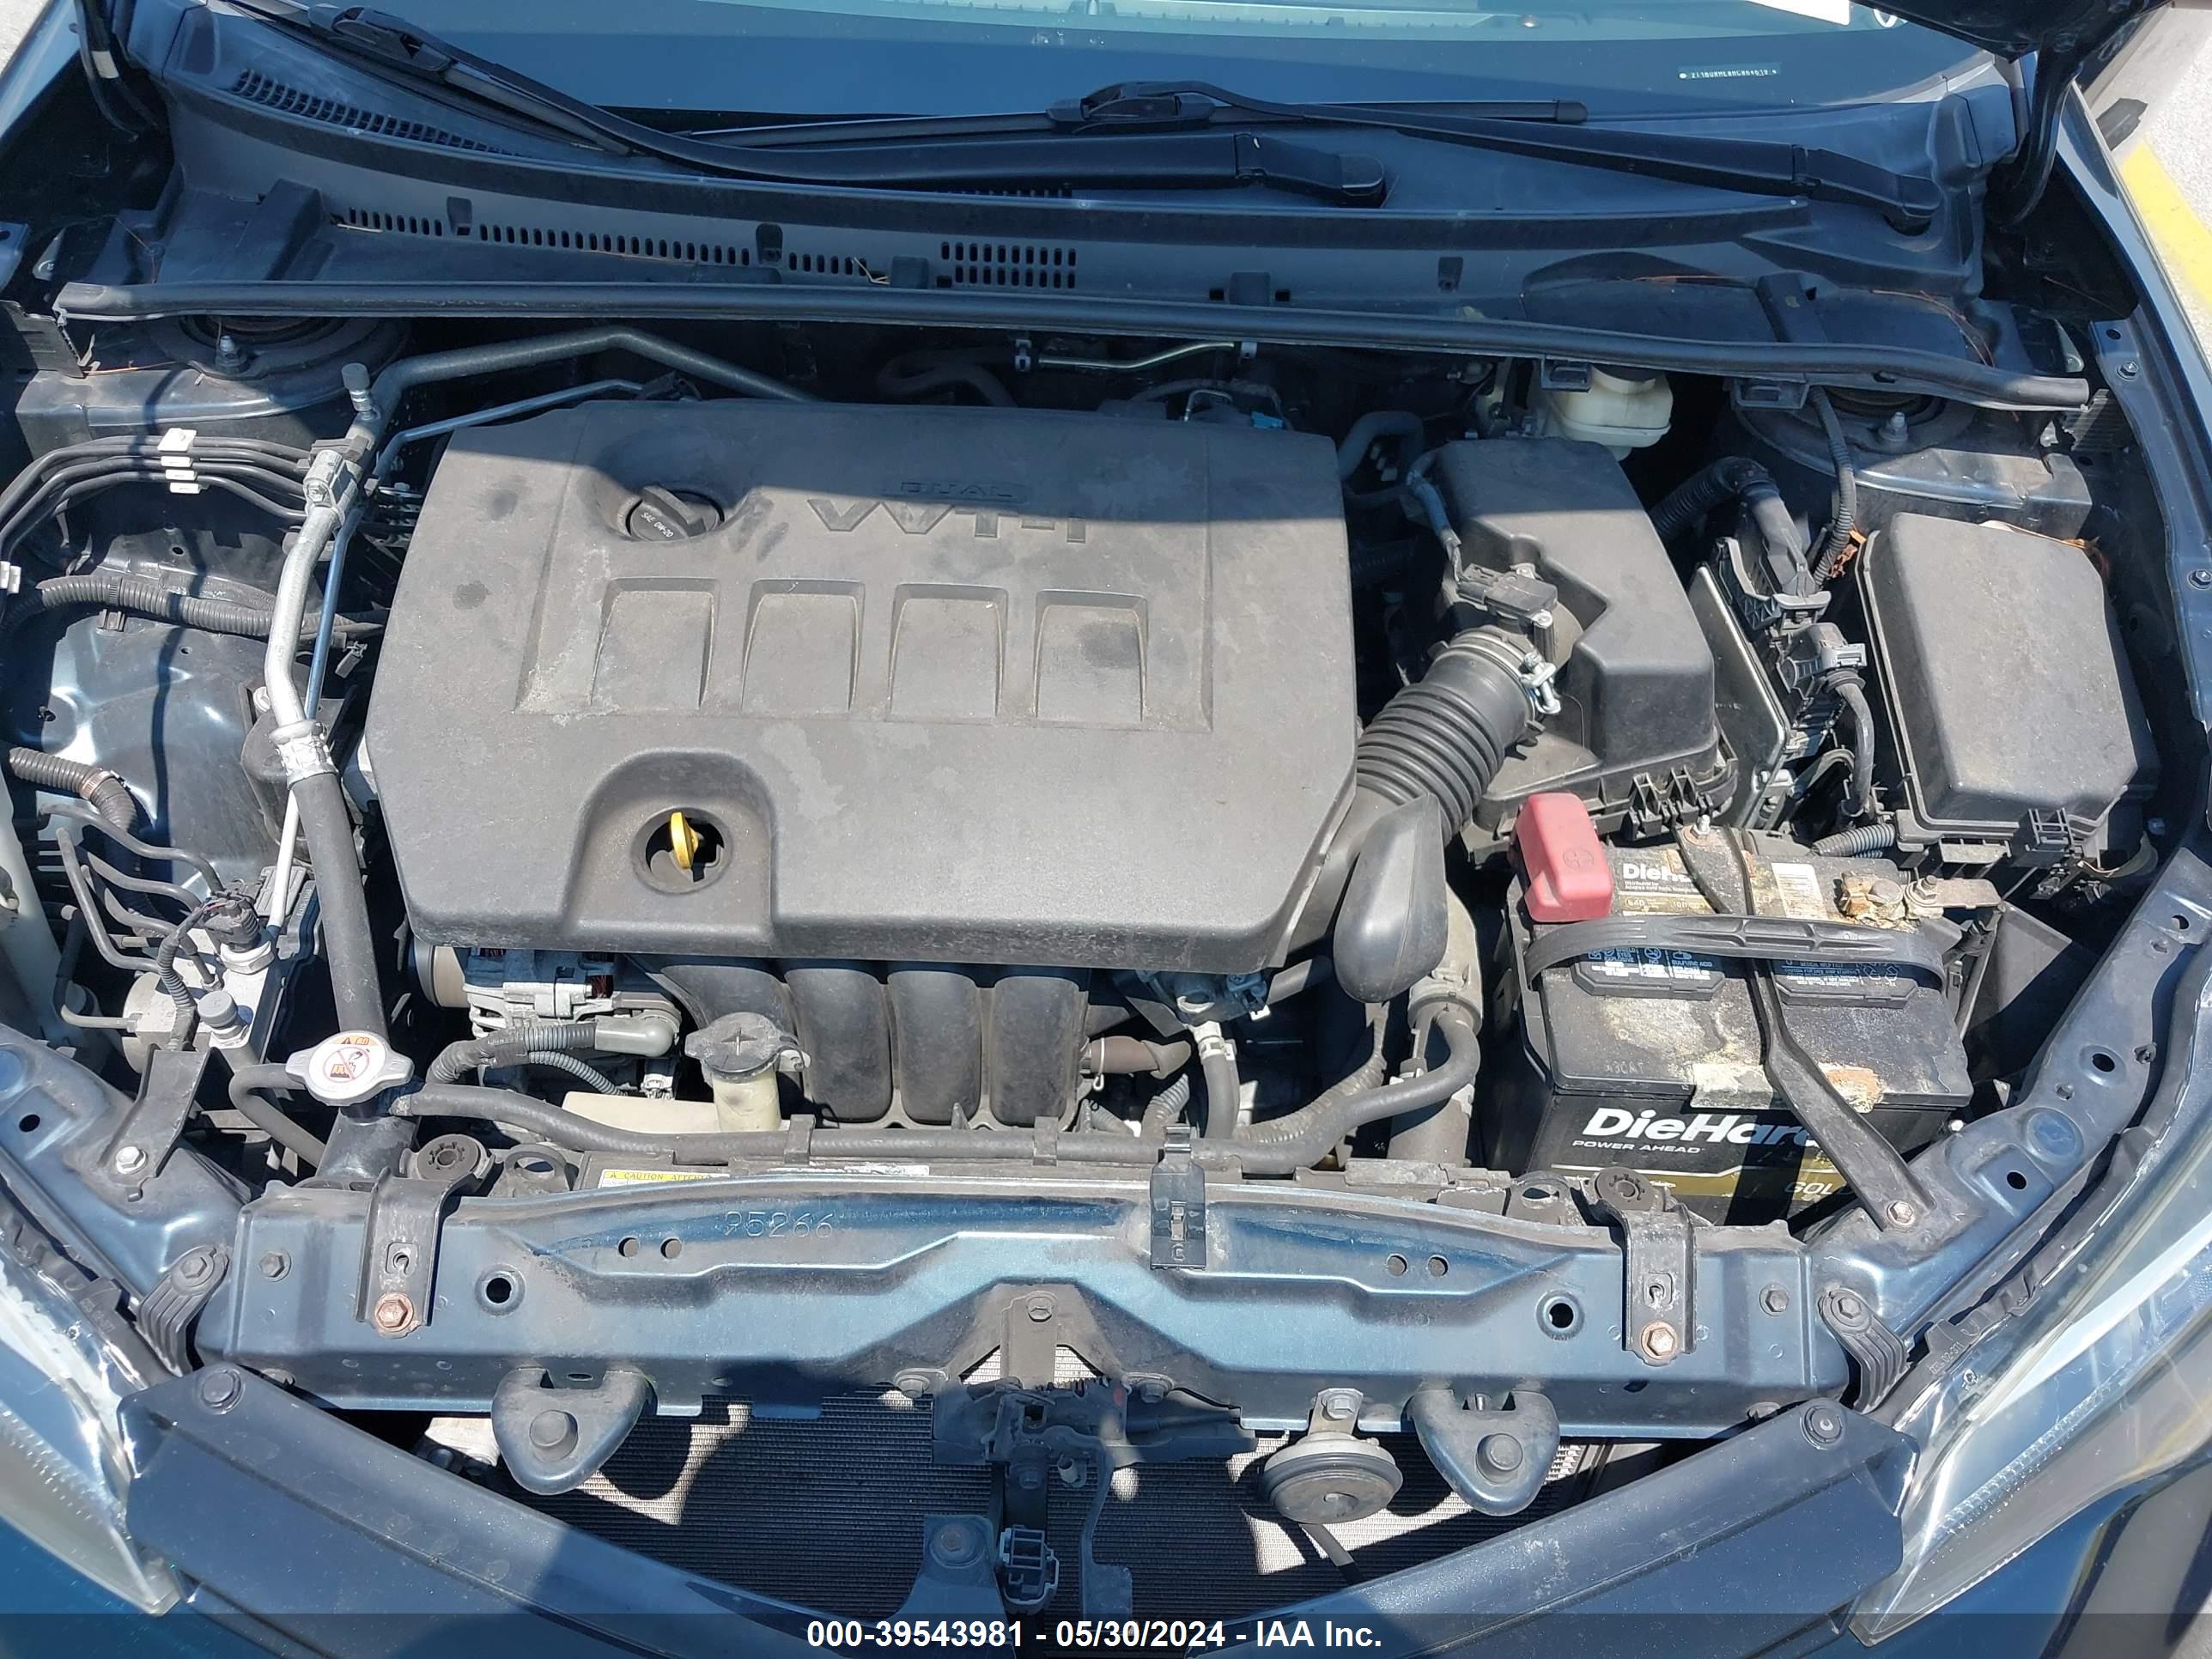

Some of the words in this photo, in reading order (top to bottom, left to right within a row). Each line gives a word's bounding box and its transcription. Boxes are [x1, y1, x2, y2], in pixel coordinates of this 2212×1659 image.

[900, 481, 1016, 499] DUAL
[641, 512, 656, 523] SAE
[1572, 1139, 1635, 1151] POWER
[1638, 1144, 1702, 1154] AHEAD
[624, 1172, 664, 1181] CAUTION
[724, 1211, 834, 1238] 95266
